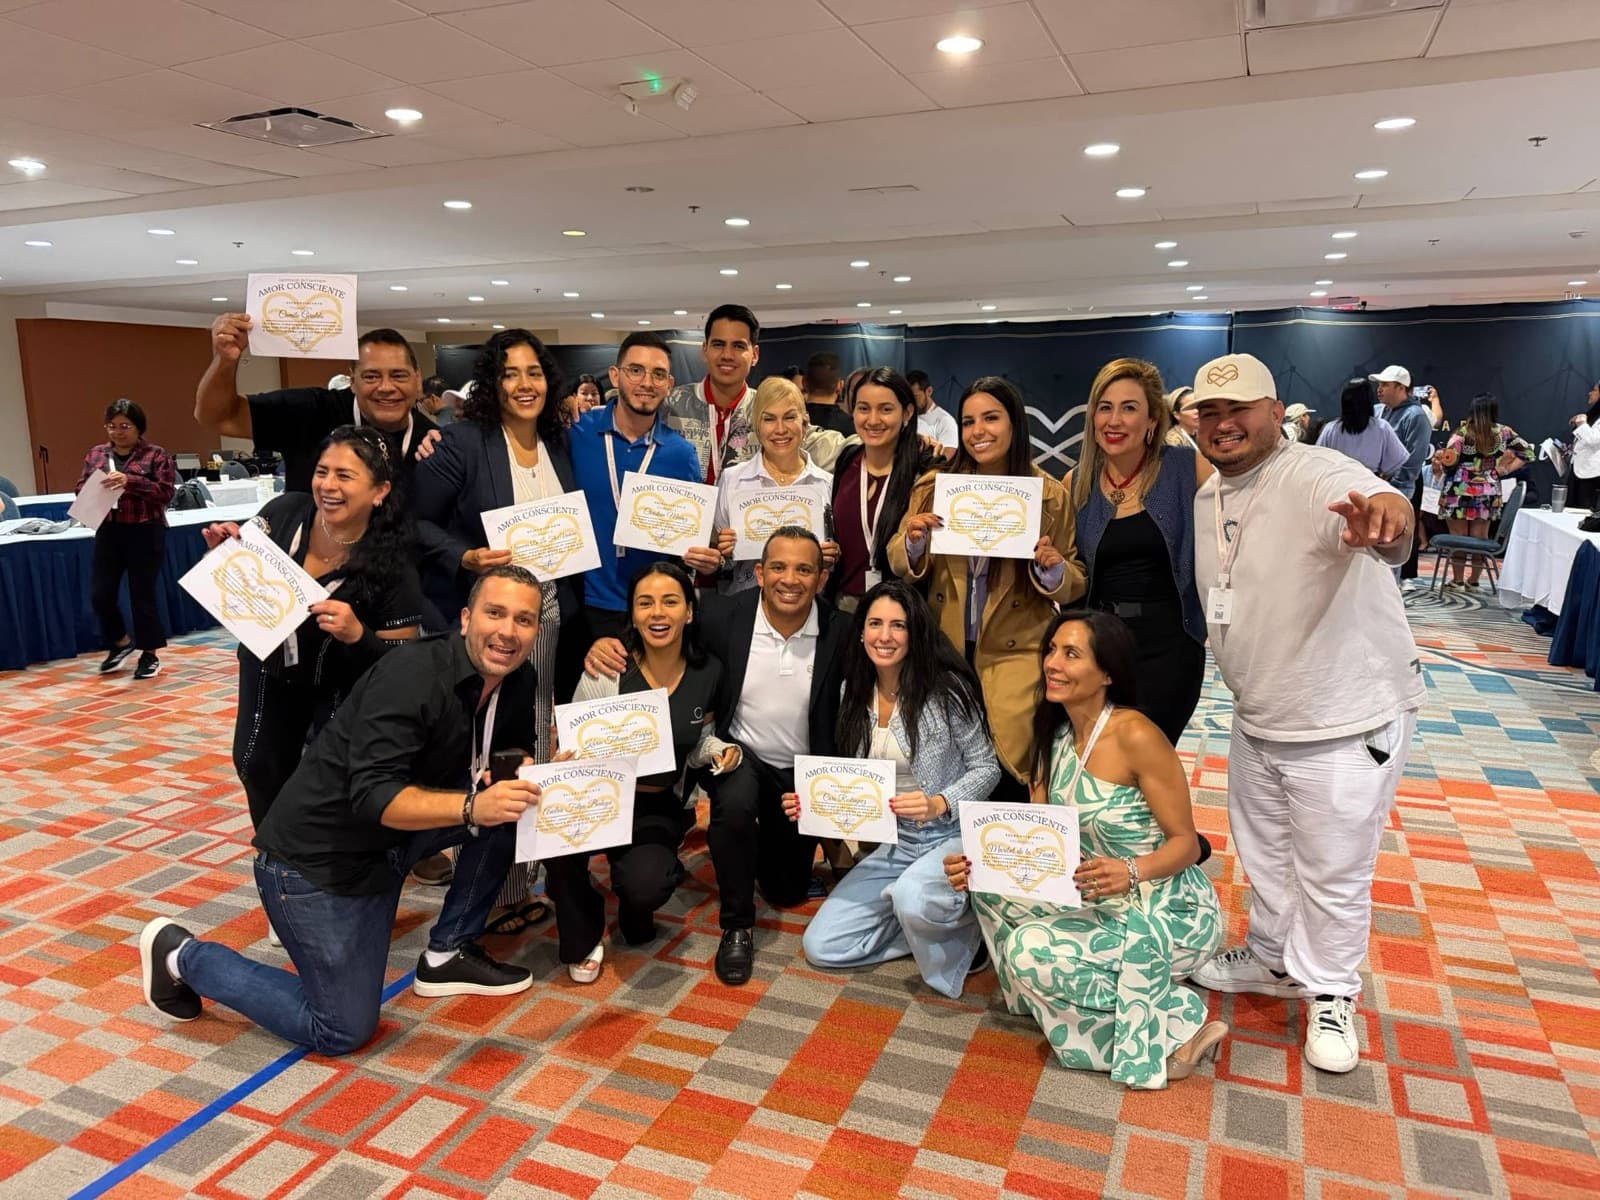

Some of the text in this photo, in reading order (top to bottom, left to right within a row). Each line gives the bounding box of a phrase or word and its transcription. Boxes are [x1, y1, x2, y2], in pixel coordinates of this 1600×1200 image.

[258, 282, 347, 299] AMOR CONSCIENTE
[631, 485, 655, 495] AMOR
[656, 485, 708, 506] CONSCIENTE
[739, 494, 815, 511] AMOR CONSCIENTE
[945, 483, 1032, 501] AMOR CONSCIENTE
[496, 515, 522, 534] AMOR
[522, 506, 579, 520] CONSCIENTE
[238, 539, 267, 556] AMOR
[264, 551, 307, 605] CONSCIENTE
[568, 710, 598, 729] AMOR
[598, 703, 659, 716] CONSCIENTE
[537, 774, 562, 789] MOR
[563, 768, 626, 782] CONSCIENTE
[805, 765, 886, 784] AMOR CONSCIENTE
[972, 812, 1069, 835] AMOR CONSCIENTE
